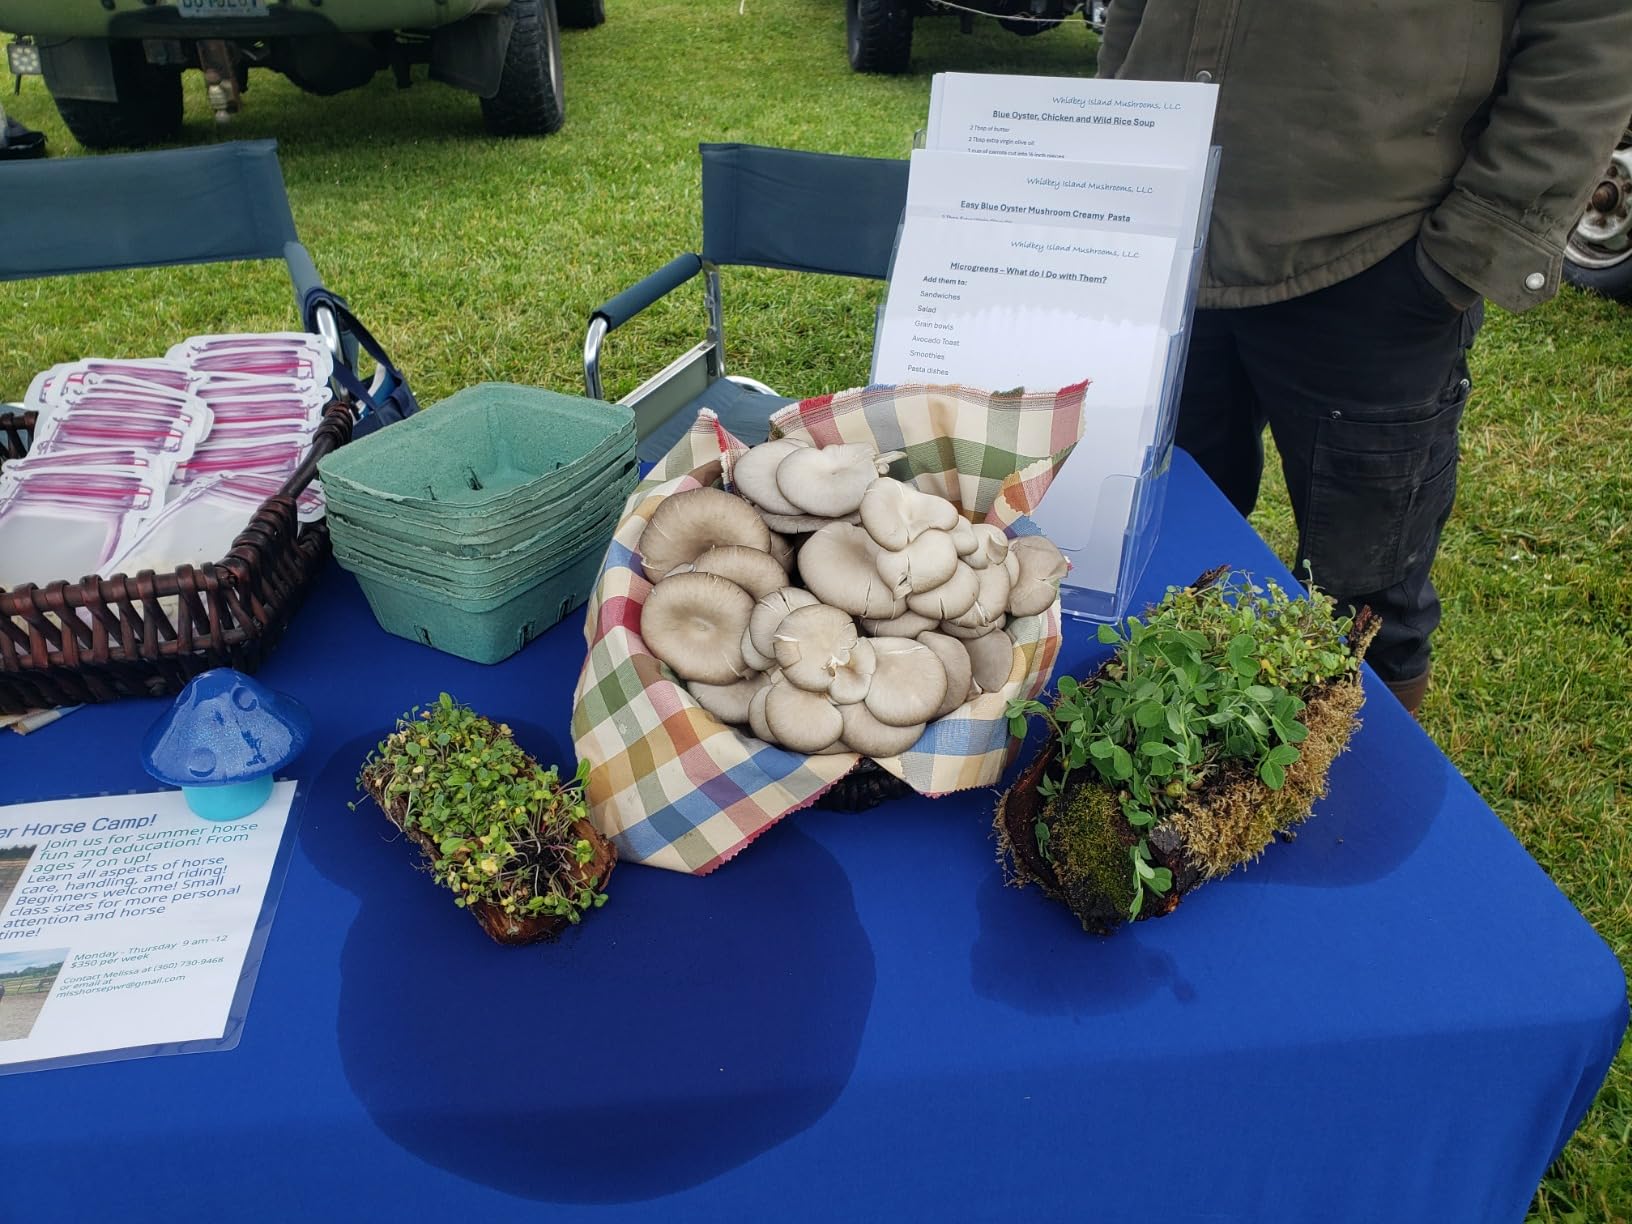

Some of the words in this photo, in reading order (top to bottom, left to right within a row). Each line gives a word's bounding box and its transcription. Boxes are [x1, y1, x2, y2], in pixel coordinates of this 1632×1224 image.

[1052, 97, 1086, 108] Whidbey
[1115, 100, 1160, 110] Mushrooms,
[993, 110, 1010, 118] Blue
[1012, 112, 1039, 121] Oyster,
[1042, 113, 1074, 122] Chicken
[1076, 115, 1090, 123] and
[1093, 116, 1111, 124] Wild
[1114, 117, 1131, 126] Rice
[1133, 118, 1155, 128] Soup
[1026, 178, 1060, 190] Whidbey
[1062, 180, 1086, 188] Island
[1088, 183, 1134, 192] Mushrooms,
[1136, 186, 1153, 194] LLC
[960, 200, 980, 210] Easy
[981, 202, 998, 210] Blue
[1000, 204, 1028, 214] Oyster
[1028, 206, 1071, 217] Mushroom
[1072, 210, 1104, 220] Creamy
[1108, 214, 1131, 222] Pasta
[1011, 240, 1044, 252] Whidbey
[1046, 244, 1070, 252] Island
[1073, 246, 1119, 256] Mushrooms,
[1122, 250, 1140, 258] LLC
[950, 262, 999, 273] Microgreens
[1006, 267, 1028, 276] What
[1030, 270, 1040, 278] do
[1059, 272, 1078, 281] with
[1079, 274, 1107, 284] Them?
[920, 290, 960, 300] Sandwiches
[918, 305, 936, 313] Salad
[914, 320, 932, 328] Grain
[934, 322, 953, 330] bowls
[912, 336, 940, 344] Avocado
[942, 338, 960, 346] Toast
[910, 350, 944, 360] Smoothies
[927, 368, 948, 376] dishes
[22, 822, 86, 836] Horse
[92, 814, 157, 831] Camp!
[40, 850, 68, 860] fun
[74, 846, 108, 858] and
[112, 837, 201, 854] education!
[206, 834, 248, 844] From
[42, 839, 76, 851] Join
[83, 838, 102, 846] us
[108, 834, 133, 844] for
[136, 828, 208, 840] summer
[212, 824, 258, 833] horse
[27, 874, 72, 884] Learn
[77, 870, 96, 879] all
[100, 864, 157, 878] aspects
[162, 860, 180, 870] of
[182, 857, 224, 868] horse
[33, 862, 75, 874] ages
[82, 860, 92, 868] 7
[96, 858, 118, 868] on
[124, 853, 151, 865] up!
[22, 884, 58, 894] care,
[65, 877, 138, 890] handling,
[144, 872, 174, 882] and
[178, 865, 228, 878] riding!
[10, 907, 49, 916] class
[54, 902, 94, 912] sizes
[98, 899, 122, 909] for
[126, 894, 168, 906] more
[171, 885, 240, 903] personal
[16, 892, 98, 906] Beginners
[103, 882, 177, 898] welcome!
[182, 876, 224, 889] Small
[4, 914, 80, 928] attention
[84, 910, 115, 921] and
[120, 906, 166, 918] horse
[70, 960, 98, 968] $350
[99, 958, 118, 967] per
[122, 953, 150, 962] week
[74, 951, 118, 961] Monday
[128, 943, 176, 954] Thursday
[63, 974, 102, 984] Contact
[103, 968, 139, 978] Melissa
[153, 962, 178, 972] (360)
[180, 957, 224, 967] 730-9468
[56, 974, 186, 998] misshorsepwr@gmail.com
[73, 980, 101, 989] email
